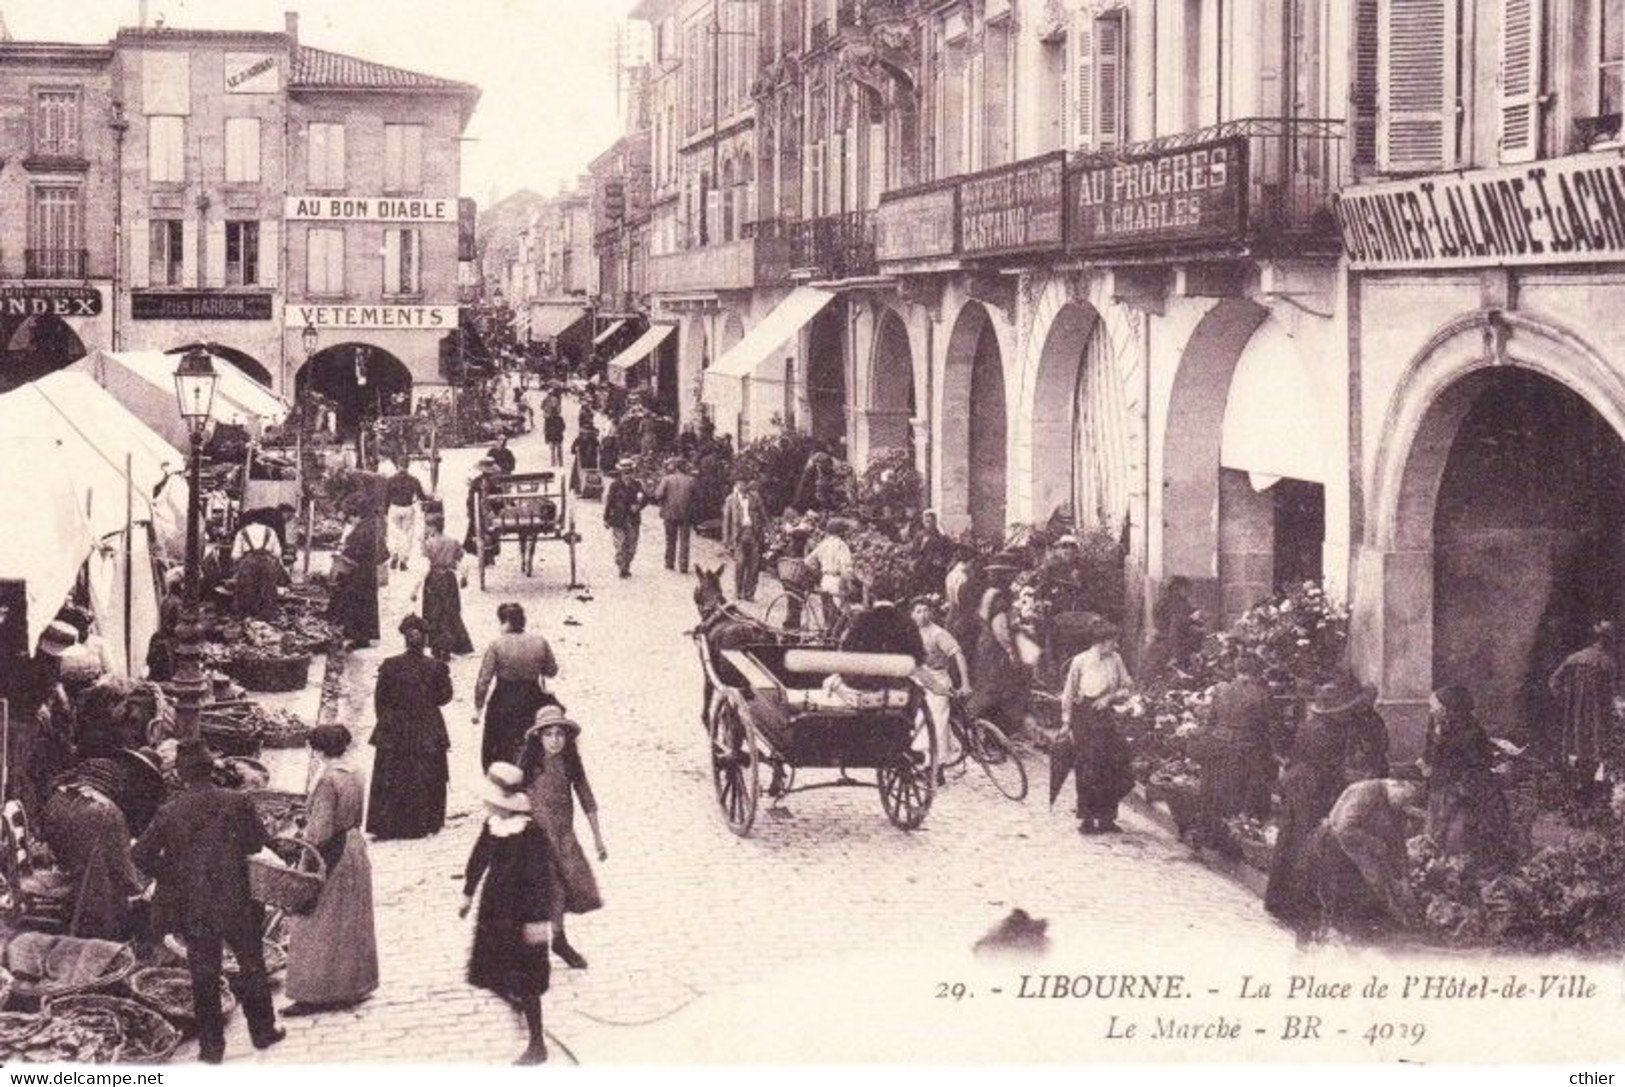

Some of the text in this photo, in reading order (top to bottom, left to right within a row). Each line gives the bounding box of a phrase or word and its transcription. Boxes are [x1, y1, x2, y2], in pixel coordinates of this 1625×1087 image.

[1079, 170, 1106, 205] AU
[1112, 148, 1227, 201] PROGRES
[297, 199, 447, 219] AU BON DIABLE
[1095, 209, 1106, 233] A
[1112, 196, 1201, 231] CHARLES
[0, 298, 96, 315] NDEX
[300, 306, 444, 326] VETEMENTS
